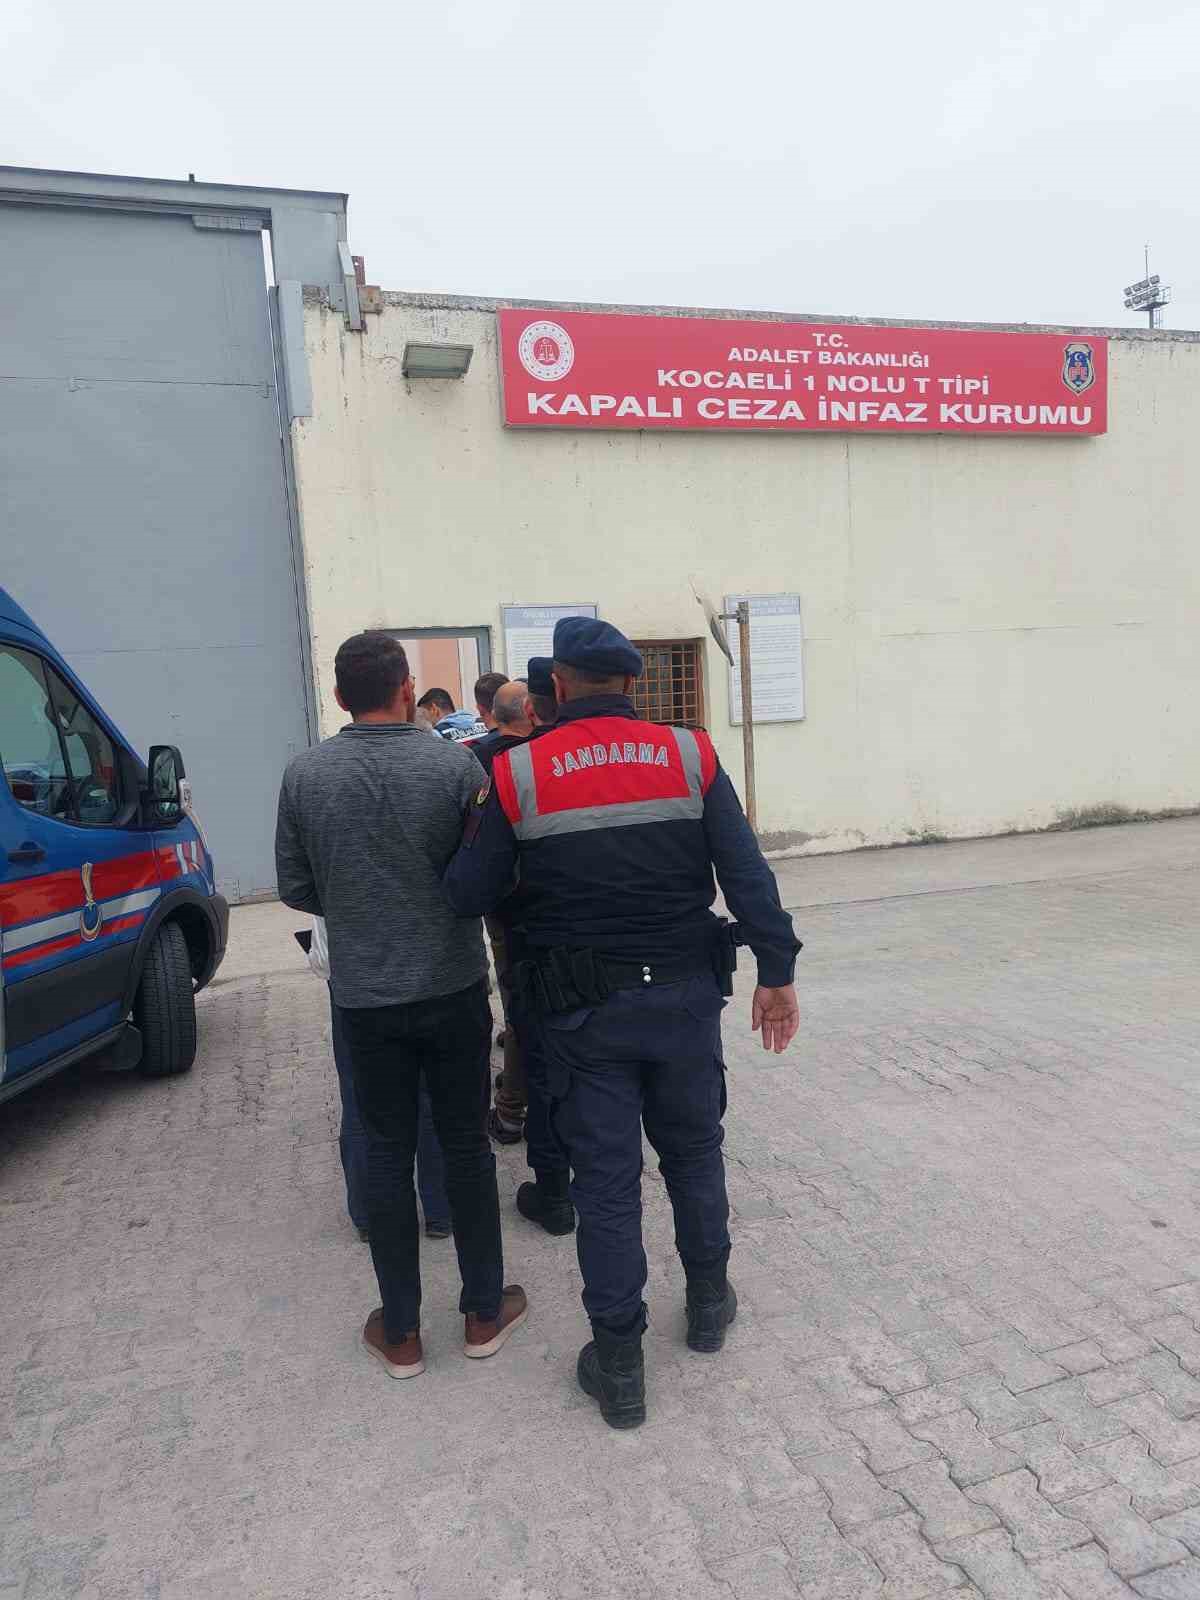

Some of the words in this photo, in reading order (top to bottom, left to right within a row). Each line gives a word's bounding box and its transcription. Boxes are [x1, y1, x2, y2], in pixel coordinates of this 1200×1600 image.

[812, 332, 849, 348] T.C.
[727, 347, 812, 365] ADALET
[818, 350, 930, 369] BAKANLIĞI
[656, 368, 793, 391] KOCAELİ
[803, 375, 816, 391] 1
[827, 374, 906, 394] NOLU
[913, 377, 931, 394] T
[938, 373, 990, 396] TİPİ
[526, 391, 683, 419] KAPALI
[696, 397, 805, 421] CEZA
[817, 395, 929, 424] İNFAZ
[939, 402, 1092, 426] KURUMU
[551, 742, 670, 777] JANDARMA
